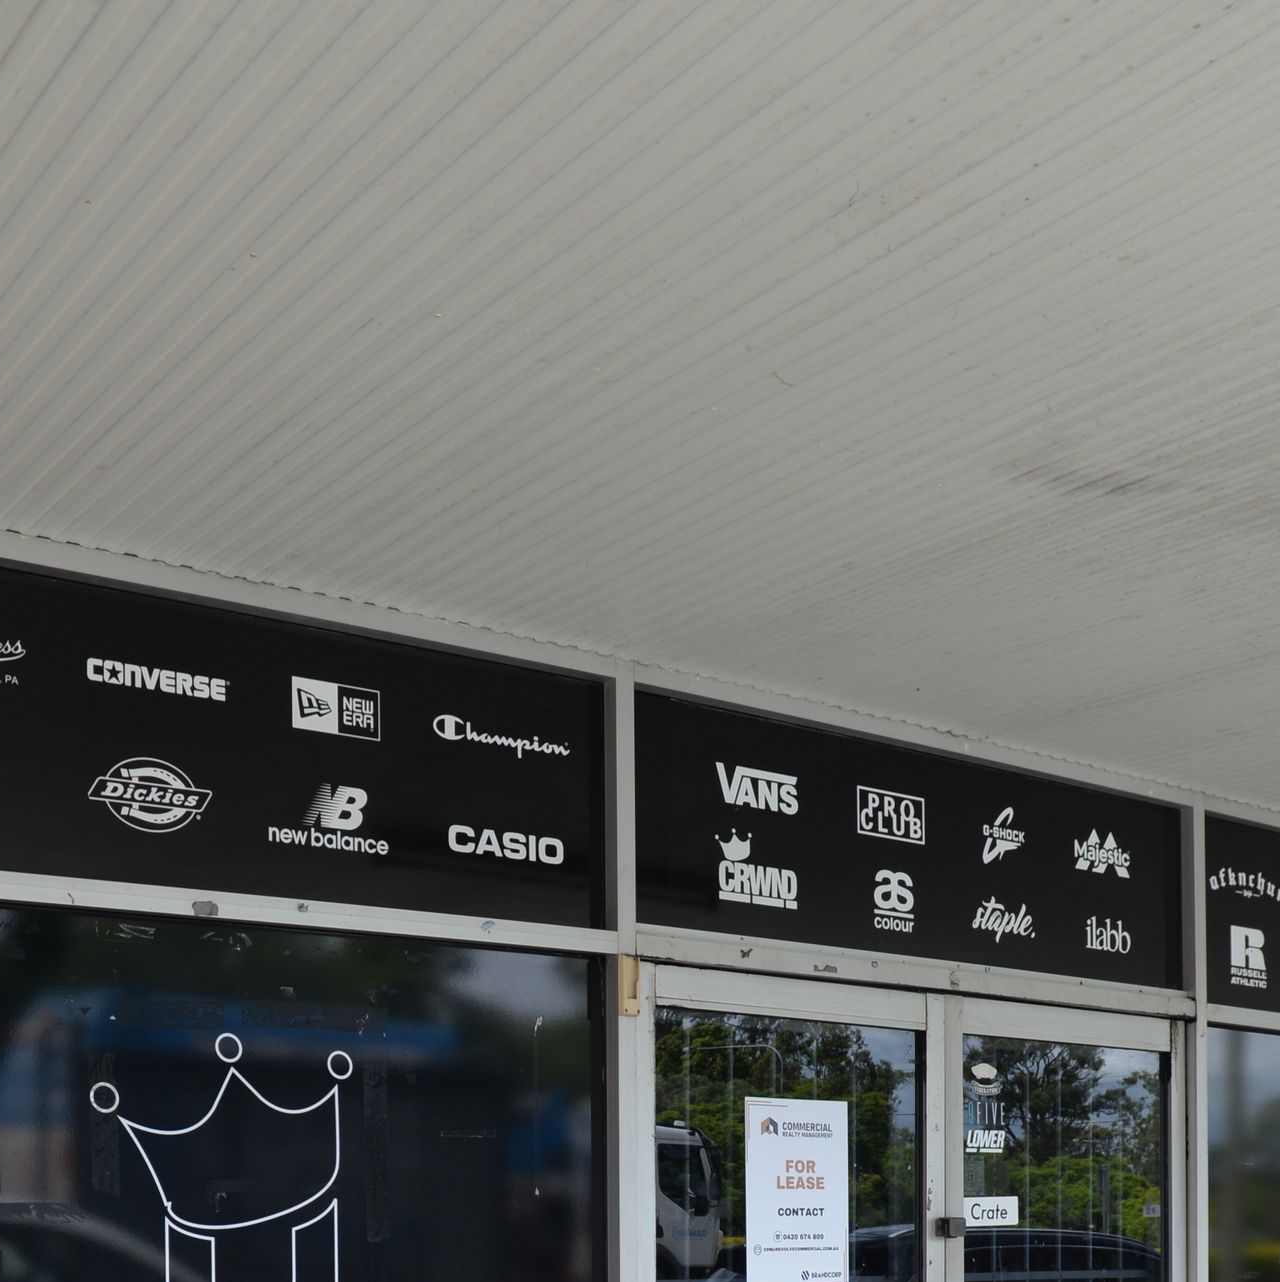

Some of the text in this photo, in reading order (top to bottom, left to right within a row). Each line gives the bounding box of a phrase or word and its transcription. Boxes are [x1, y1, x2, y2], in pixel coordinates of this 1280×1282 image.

[4, 674, 20, 686] PA
[86, 657, 227, 702] CONVERSE
[342, 695, 375, 716] NEW
[342, 712, 375, 730] ERA
[432, 714, 571, 759] Champion
[98, 778, 200, 809] Dickies
[715, 761, 799, 815] VANS
[867, 792, 916, 822] PRO
[860, 807, 923, 840] CLUB
[982, 824, 1026, 843] G-SHOCK
[268, 824, 390, 856] new balance
[447, 824, 565, 866] CASIO
[1073, 838, 1131, 868] Majestic
[718, 859, 799, 901] CRWND
[873, 916, 915, 934] colour
[1085, 915, 1132, 955] ilabb
[1230, 966, 1268, 980] RUSSELL
[1230, 975, 1268, 989] ATHLETIC
[782, 1121, 833, 1133] COMMERCIAL
[966, 1129, 1007, 1148] LOWER
[785, 1159, 816, 1174] FOR
[776, 1175, 825, 1190] LEASE
[777, 1207, 825, 1217] CONTACT
[970, 1203, 1008, 1221] Crate
